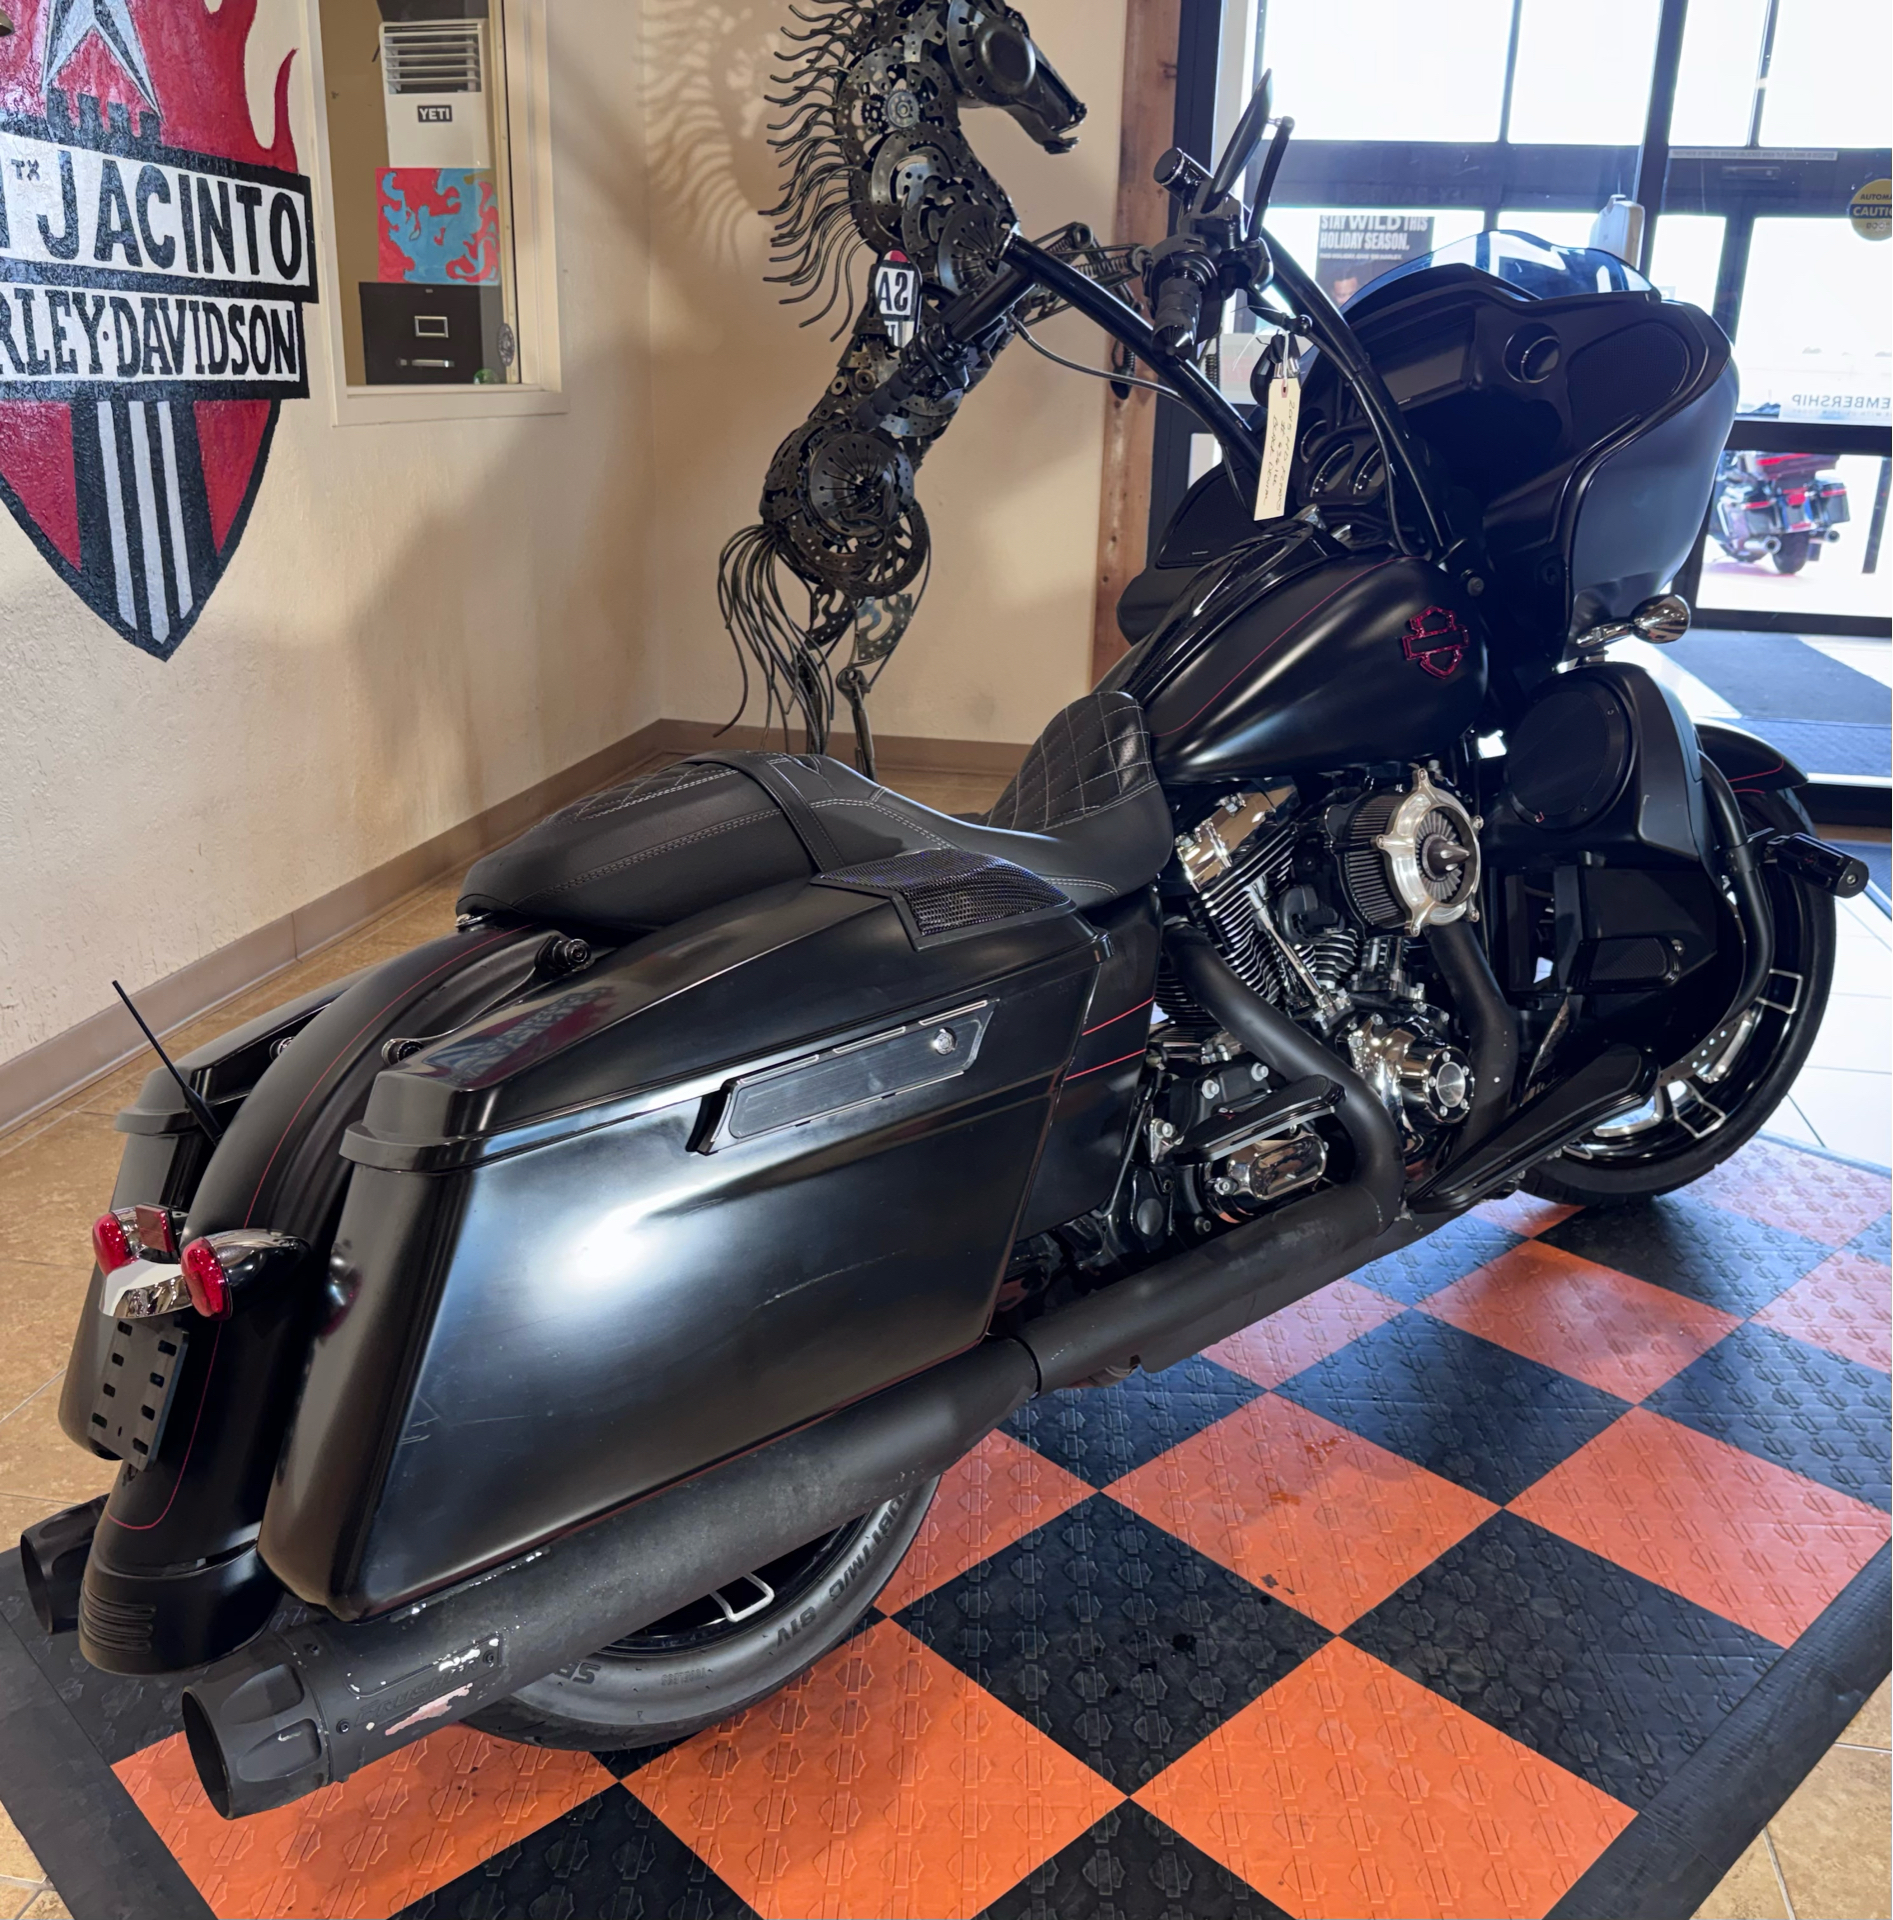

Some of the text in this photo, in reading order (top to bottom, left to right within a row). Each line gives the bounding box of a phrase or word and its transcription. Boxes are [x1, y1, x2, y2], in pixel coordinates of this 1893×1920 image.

[419, 108, 450, 120] YETI
[11, 159, 40, 181] TX
[37, 150, 302, 280] JACINTO
[1321, 215, 1429, 231] STAY WILD THIS
[1320, 232, 1410, 250] HOLIDAY SEASON.
